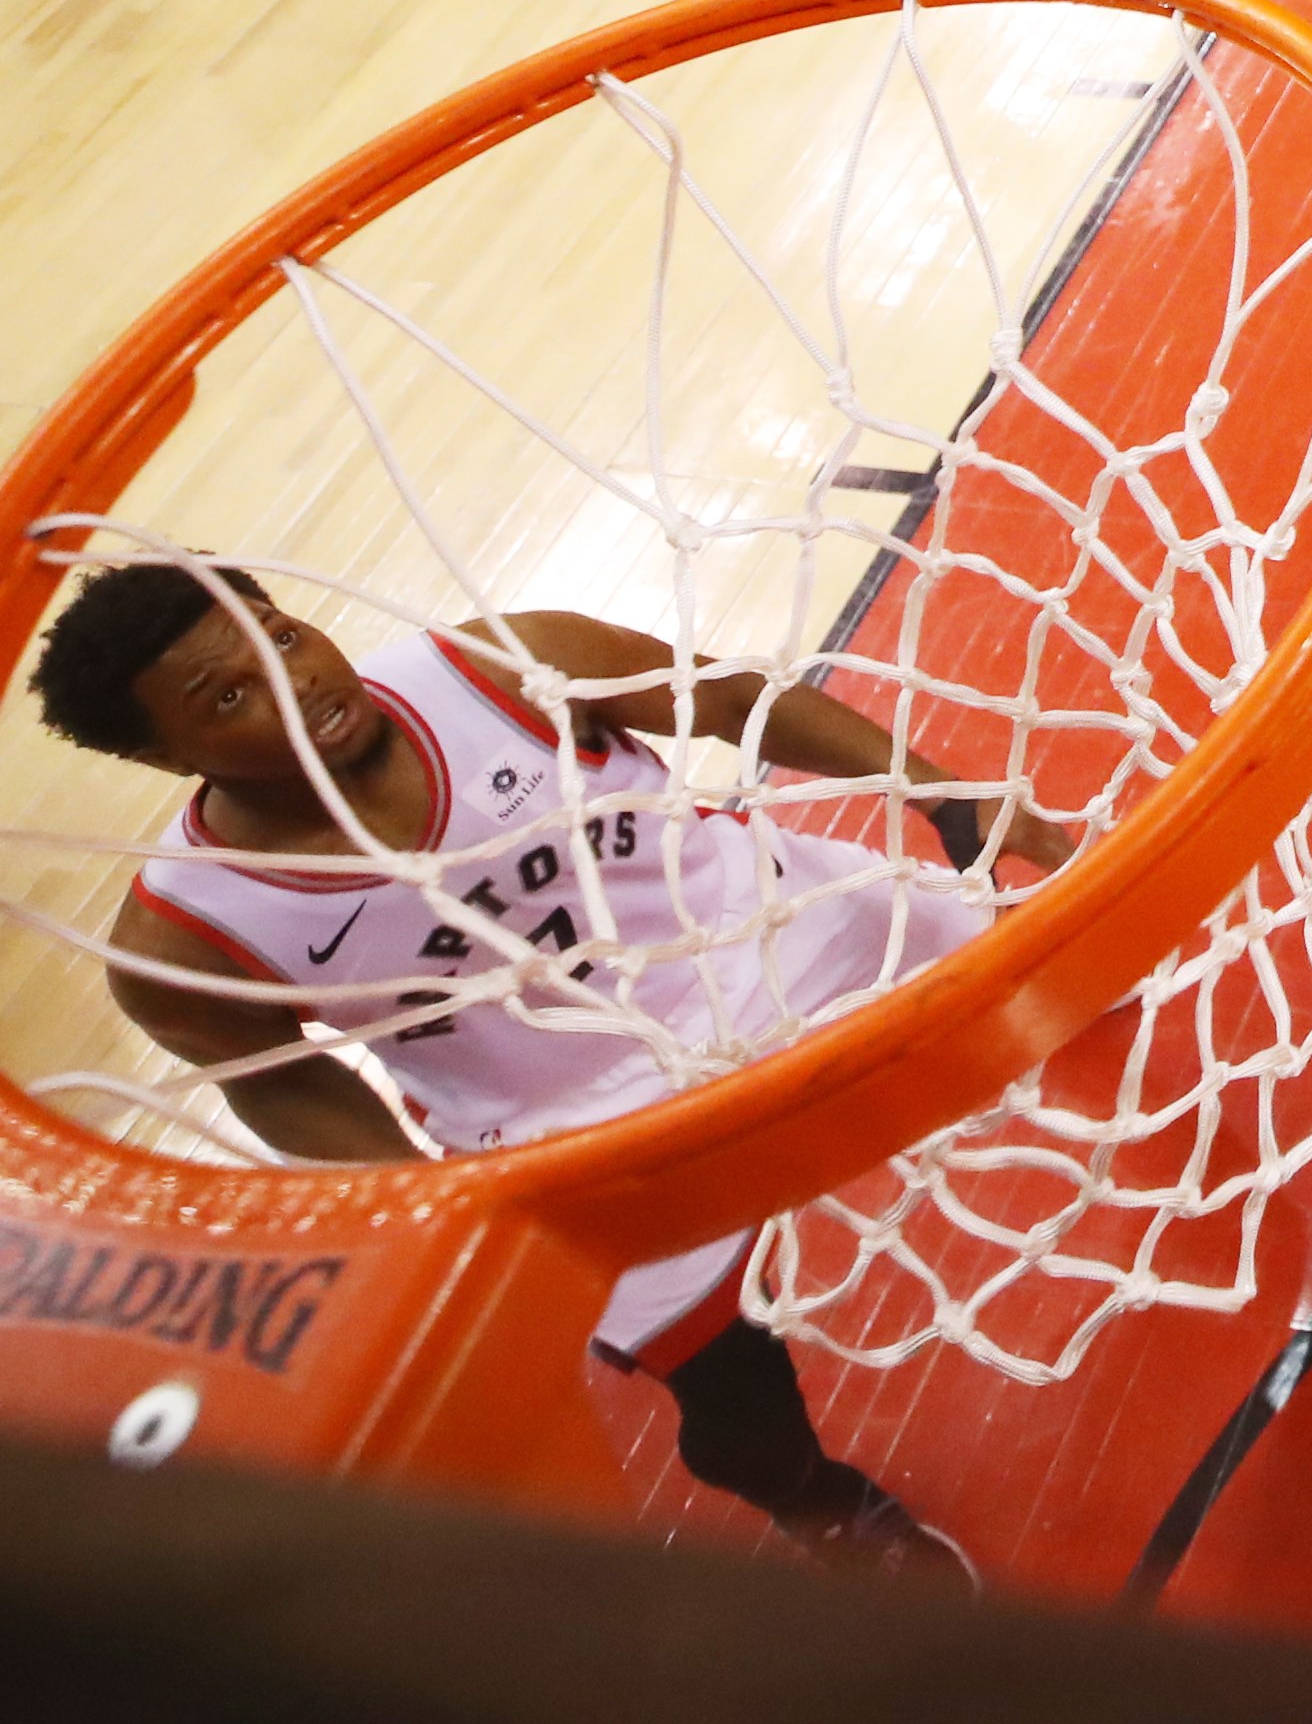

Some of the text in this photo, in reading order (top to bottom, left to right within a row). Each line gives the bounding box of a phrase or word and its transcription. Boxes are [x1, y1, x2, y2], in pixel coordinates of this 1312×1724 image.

[497, 770, 544, 822] Sun Life
[526, 905, 595, 982] 7
